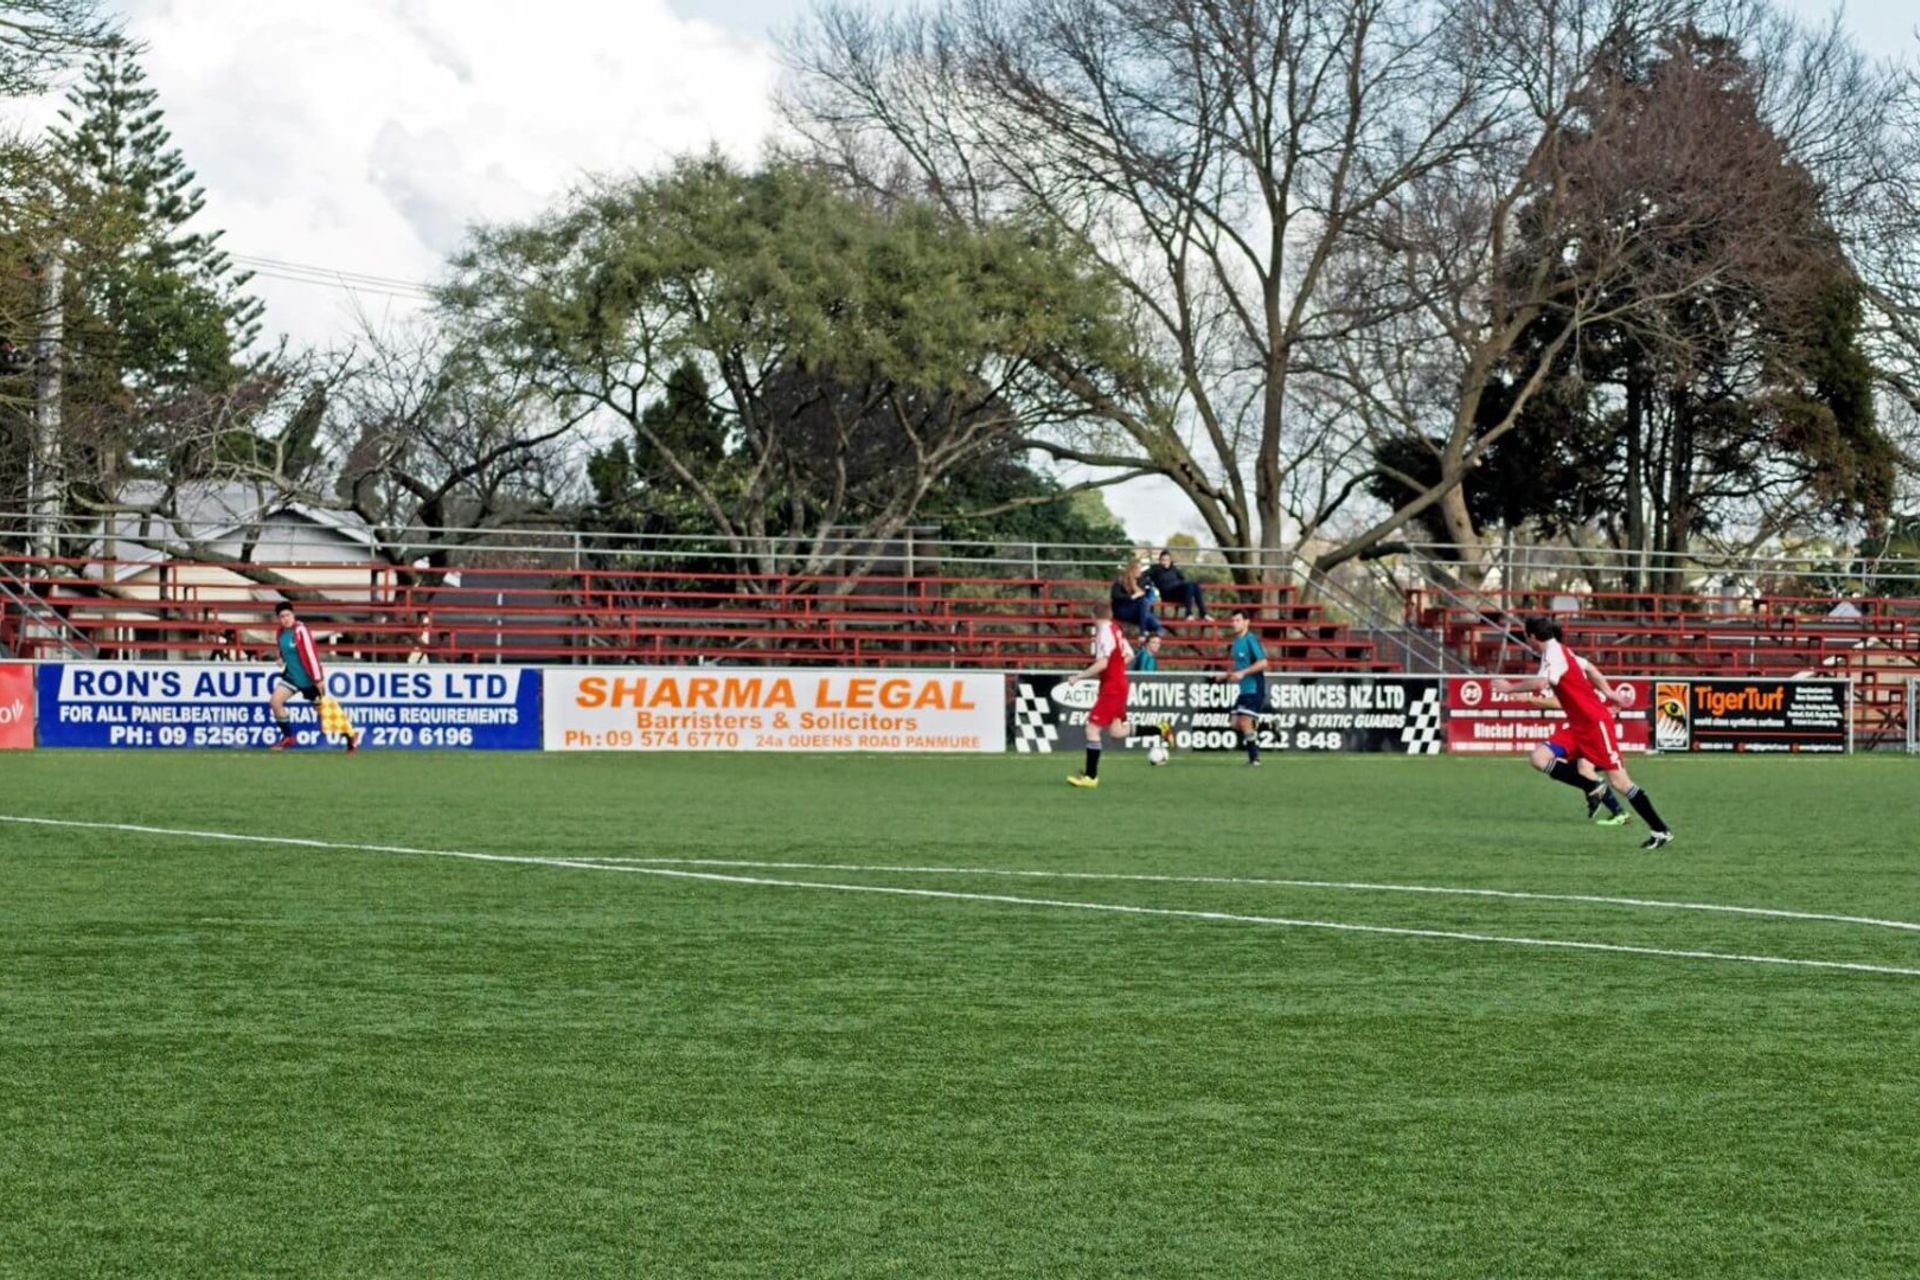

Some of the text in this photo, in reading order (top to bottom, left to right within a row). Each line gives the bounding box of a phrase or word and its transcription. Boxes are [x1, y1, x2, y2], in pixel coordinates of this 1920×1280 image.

[74, 670, 181, 697] RON'S
[328, 672, 432, 698] ODIES
[446, 673, 508, 698] LTD
[576, 676, 976, 710] SHARMA LEGAL
[1064, 689, 1099, 702] ACTI
[1127, 683, 1405, 708] ACTIVE SECUR SERVICES NZ LTD
[1694, 685, 1784, 715] TigerTurf
[60, 706, 93, 722] FOR
[97, 706, 127, 722] ALL
[132, 706, 249, 722] PANELBEATING
[253, 706, 266, 722] &
[400, 708, 518, 724] REQUIREMENTS
[637, 711, 918, 731] Barristers & Solicitors
[1127, 711, 1179, 727] ECURITY
[1191, 712, 1231, 727] MOBIL
[1308, 714, 1353, 728] STATIC
[1355, 714, 1406, 728] GUARDS
[110, 726, 152, 744] PH:
[159, 726, 187, 744] 09
[297, 730, 320, 745] or
[372, 727, 413, 745] 270
[419, 728, 473, 745] 6196
[565, 730, 739, 747] Ph: 09 574 6770
[756, 735, 980, 749] 24a QUEENS ROAD PANMURE
[1176, 731, 1237, 748] 0800
[1296, 731, 1341, 749] 848
